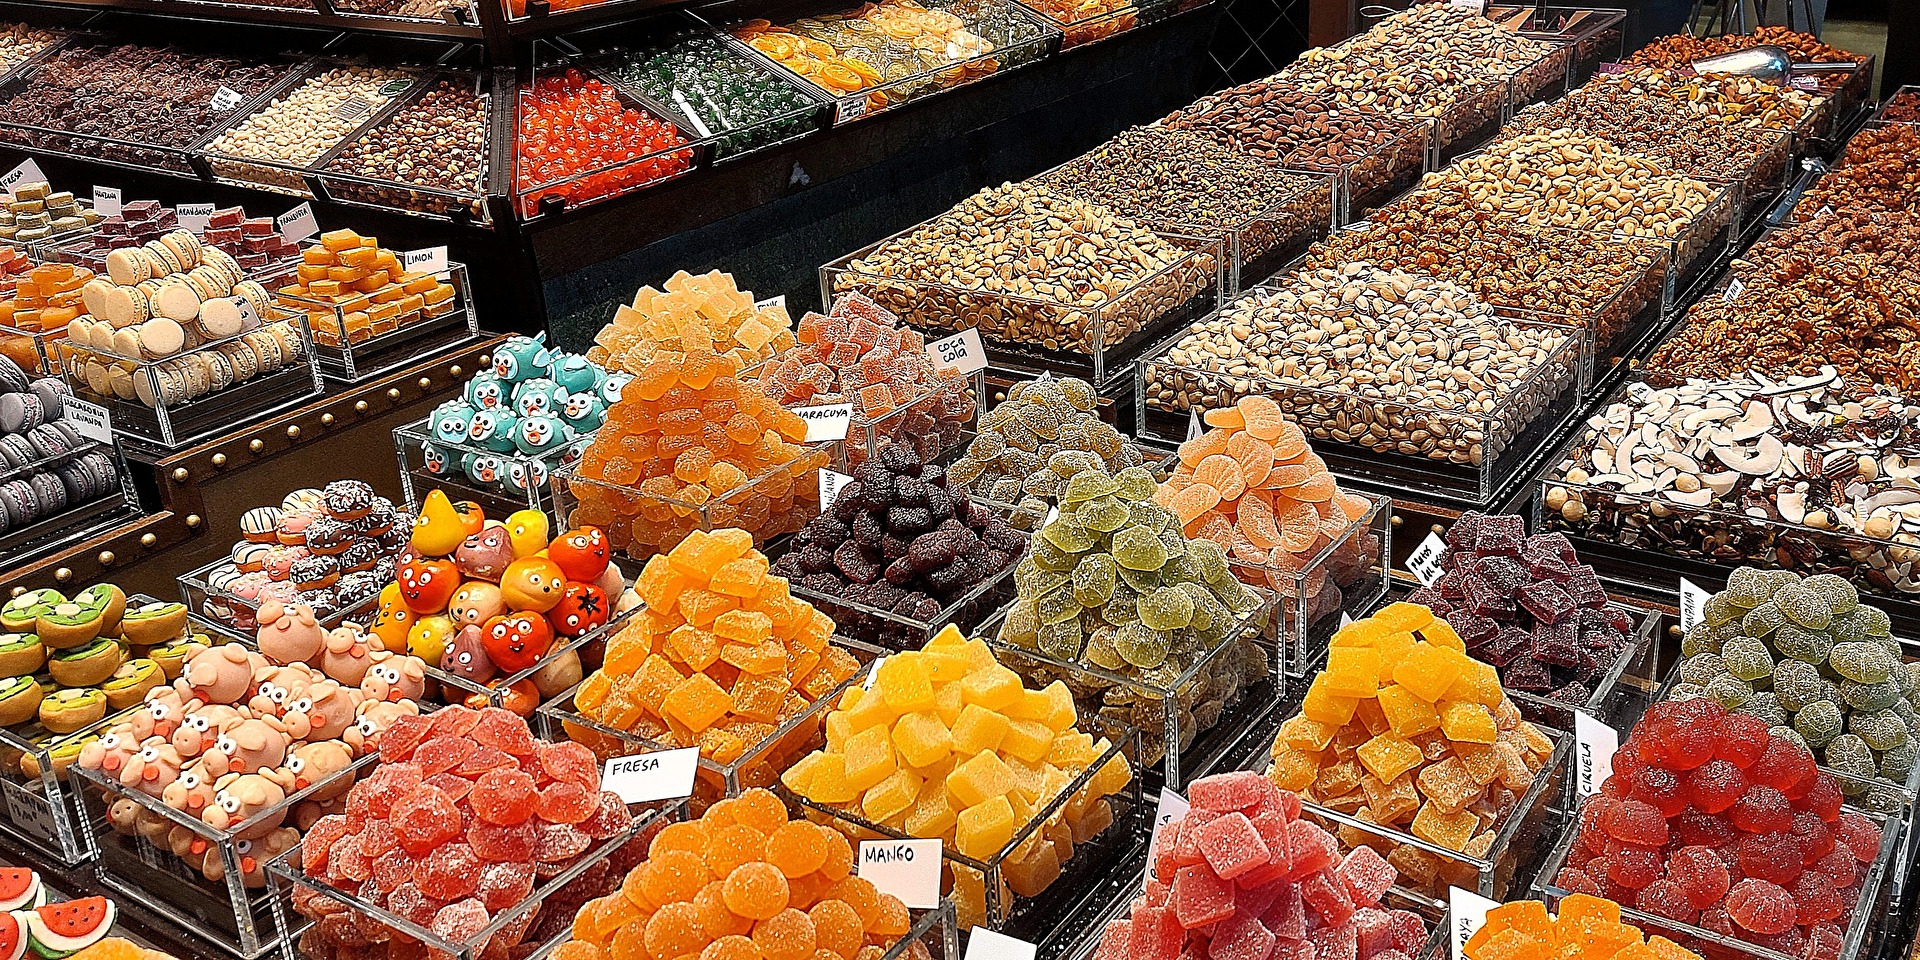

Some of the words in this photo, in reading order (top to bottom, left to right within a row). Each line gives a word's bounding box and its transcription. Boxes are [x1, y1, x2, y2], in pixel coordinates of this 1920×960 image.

[2, 169, 25, 188] FRESA
[406, 251, 434, 266] LIMON
[71, 411, 103, 429] LAVANDA
[612, 758, 660, 775] FRESA
[1582, 741, 1594, 793] CIRUELA
[865, 844, 915, 864] MANGO
